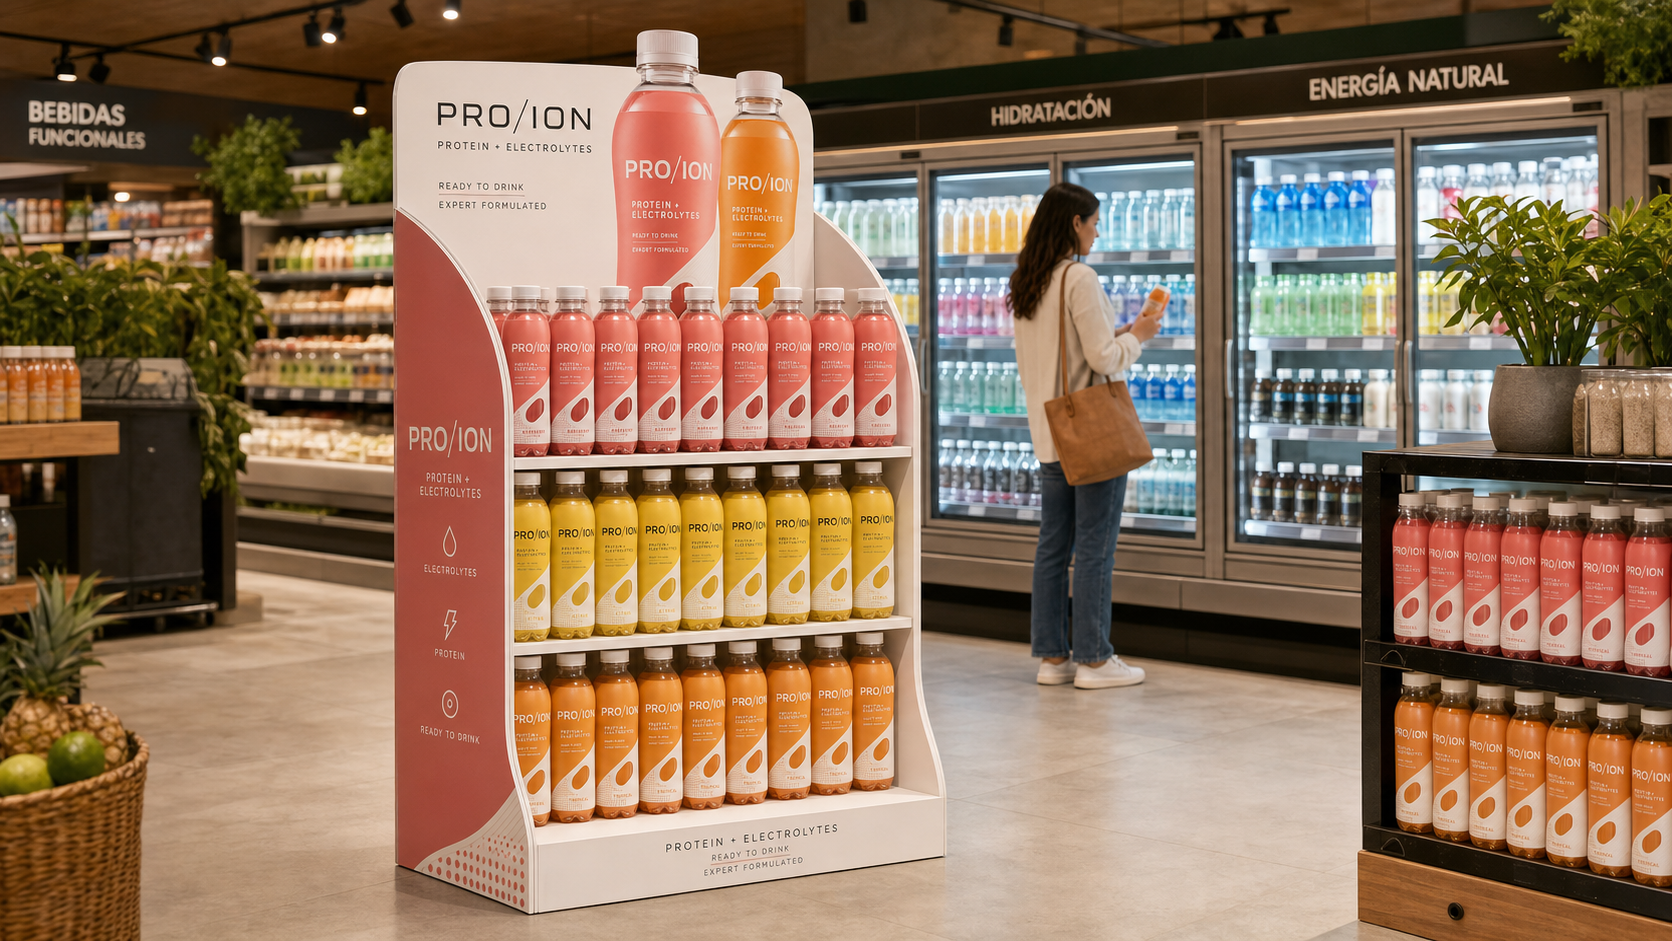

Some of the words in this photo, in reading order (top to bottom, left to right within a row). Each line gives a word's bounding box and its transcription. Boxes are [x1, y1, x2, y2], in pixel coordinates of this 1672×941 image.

[1308, 65, 1401, 100] ENERGÍA
[1408, 62, 1510, 92] NATURAL
[28, 100, 126, 127] BEBIDAS
[437, 99, 591, 134] PRO/ION
[991, 93, 1111, 126] HIDRATACIÓN
[28, 127, 146, 150] FUNCIONALES
[437, 141, 489, 150] PROTEIN
[506, 143, 592, 153] ELECTROLYTES
[625, 155, 713, 184] PRO/ION
[438, 182, 472, 190] READY
[494, 183, 524, 191] DRINK
[727, 173, 793, 195] PRO/ION
[438, 201, 476, 209] EXPERT
[481, 201, 547, 210] FORMULATED
[631, 200, 671, 209] PROTEIN
[731, 206, 763, 214] PROTEIN
[631, 211, 700, 220] ELECTROLYTES
[732, 214, 783, 223] ELECTROLYTES
[409, 420, 492, 458] PRO/ION
[426, 472, 462, 484] PROTEIN
[419, 486, 482, 499] ELECTROLYTES
[424, 564, 477, 577] ELECTROLYTES
[434, 648, 465, 660] PROTEIN
[420, 725, 443, 737] READY
[445, 728, 455, 739] TO
[457, 731, 480, 744] DRINK
[665, 837, 724, 853] PROTEIN
[743, 823, 839, 844] ELECTROLYTES
[711, 851, 742, 862] READY
[746, 849, 758, 857] TO
[761, 845, 789, 855] DRINK
[703, 864, 739, 876] EXPERT
[743, 856, 804, 871] FORMULATED
